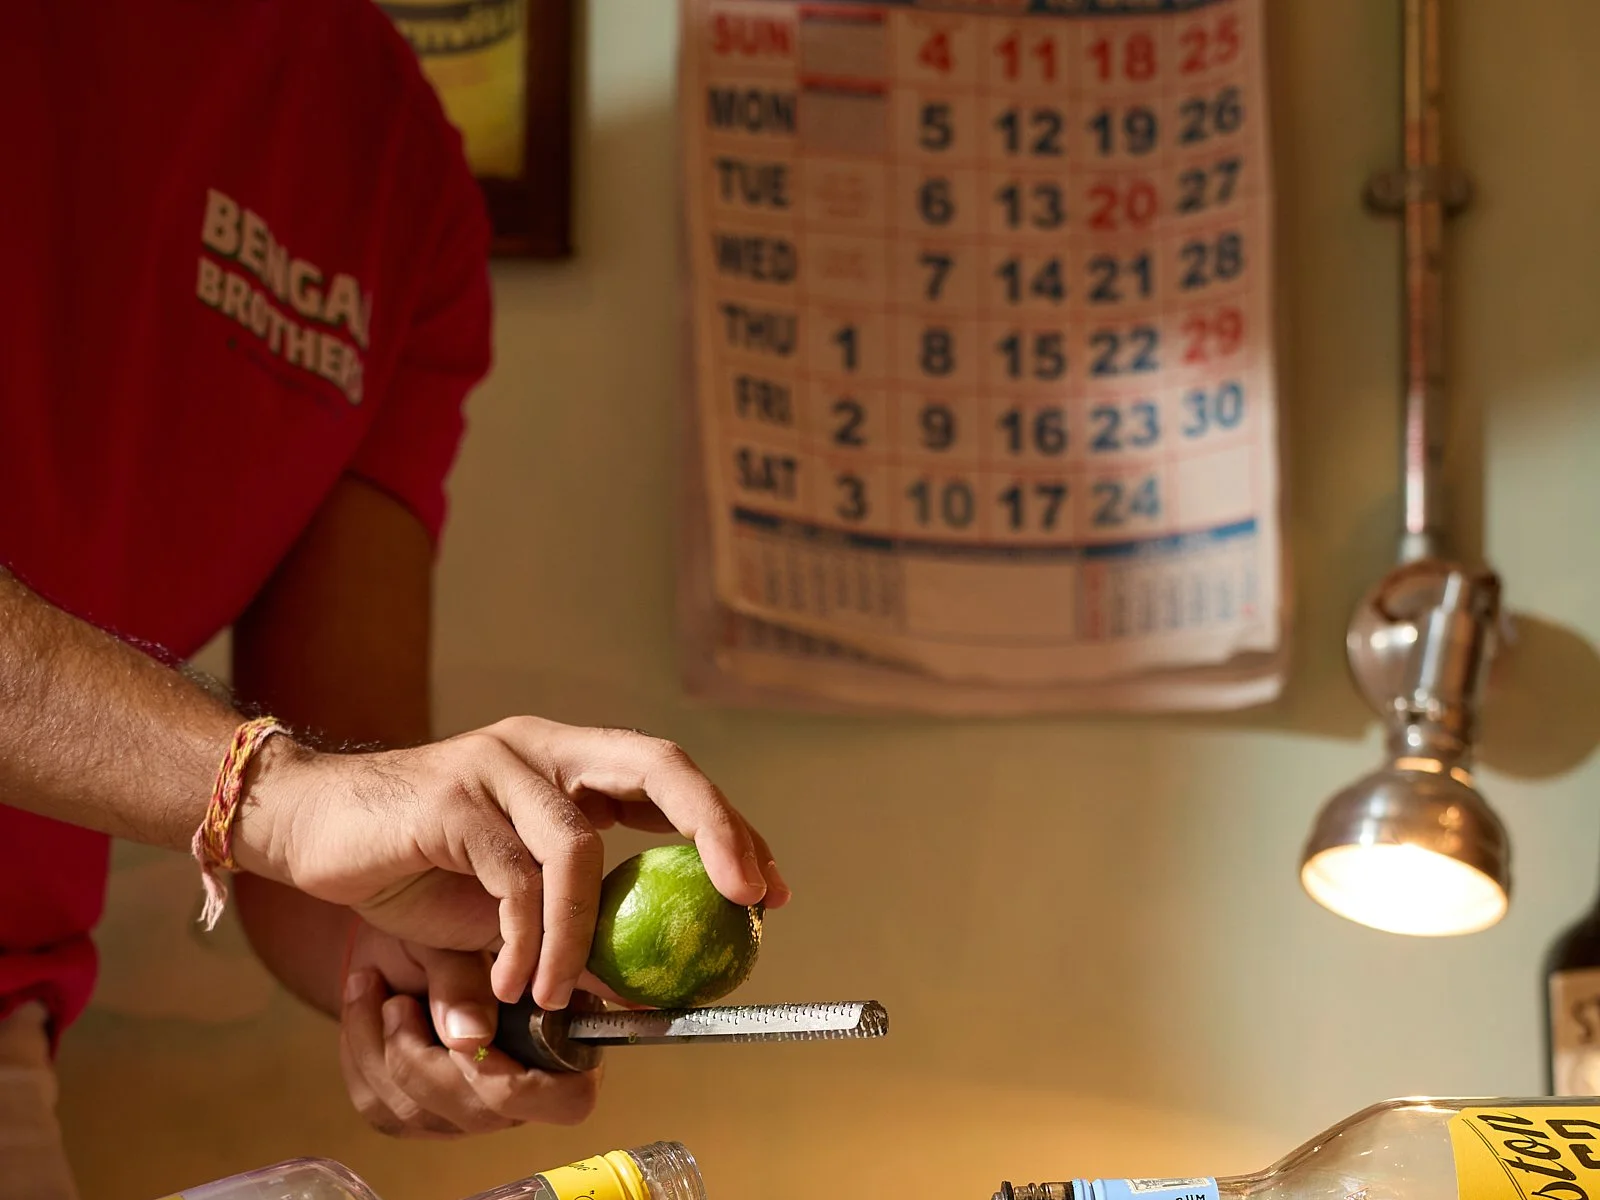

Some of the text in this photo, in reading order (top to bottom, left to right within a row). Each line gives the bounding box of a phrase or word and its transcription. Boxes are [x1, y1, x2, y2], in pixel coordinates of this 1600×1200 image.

[710, 15, 1241, 82] SUN 4 11 18 25
[708, 86, 1244, 156] MON 5 12 19 26
[713, 159, 791, 207] TUE
[918, 178, 955, 227] 6
[995, 184, 1066, 231] 13
[1088, 184, 1158, 232] 20
[1177, 160, 1243, 214] 27
[202, 187, 373, 350] BENGA
[713, 233, 796, 283] WED
[919, 255, 955, 299] 7
[995, 256, 1066, 304] 14
[1089, 255, 1152, 304] 21
[1179, 233, 1244, 290] 28
[722, 304, 1244, 380] THU 1 8 15 22 29
[733, 375, 1244, 456] FRI 2 9 16 23 30
[734, 449, 1161, 531] SAT 3 10 17 24
